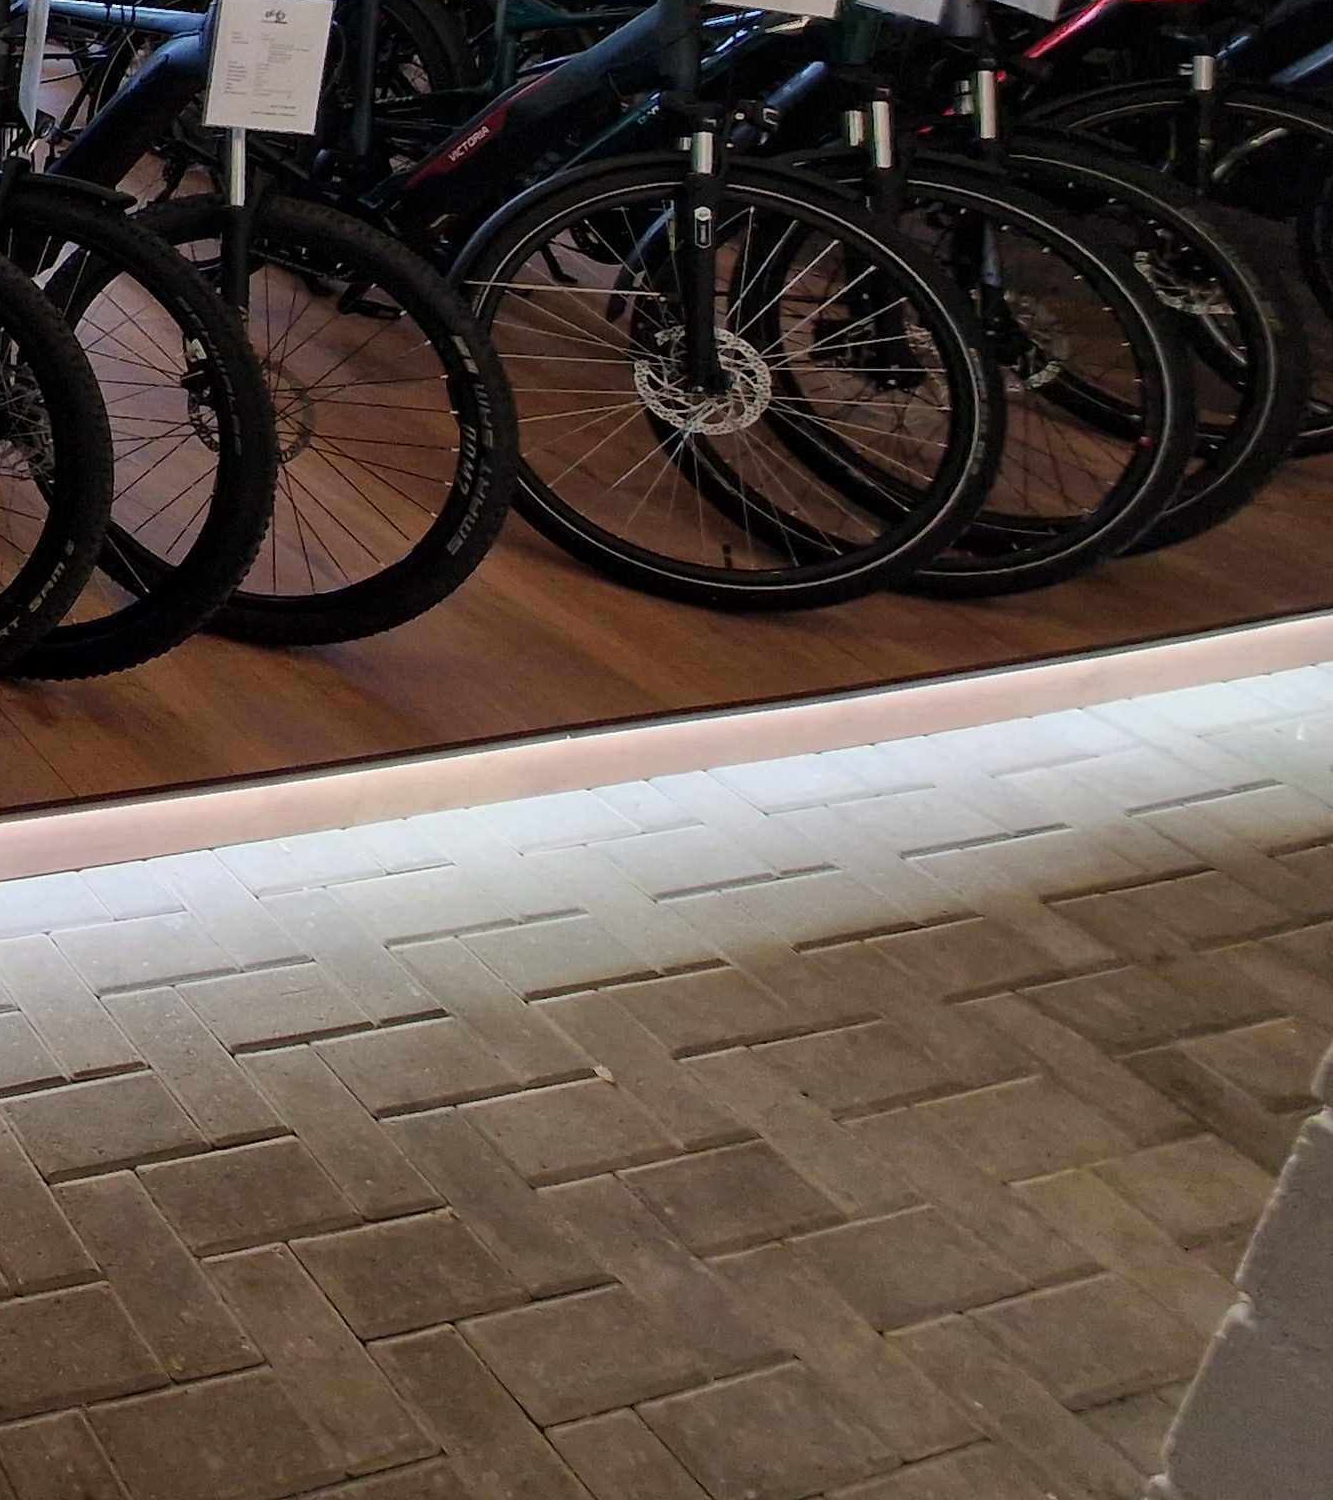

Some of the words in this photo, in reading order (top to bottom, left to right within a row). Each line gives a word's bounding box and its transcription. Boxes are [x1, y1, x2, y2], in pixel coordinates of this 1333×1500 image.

[448, 124, 490, 163] VICTORIA
[446, 457, 494, 556] SMART
[473, 381, 494, 449] SAM
[27, 561, 66, 614] SAM
